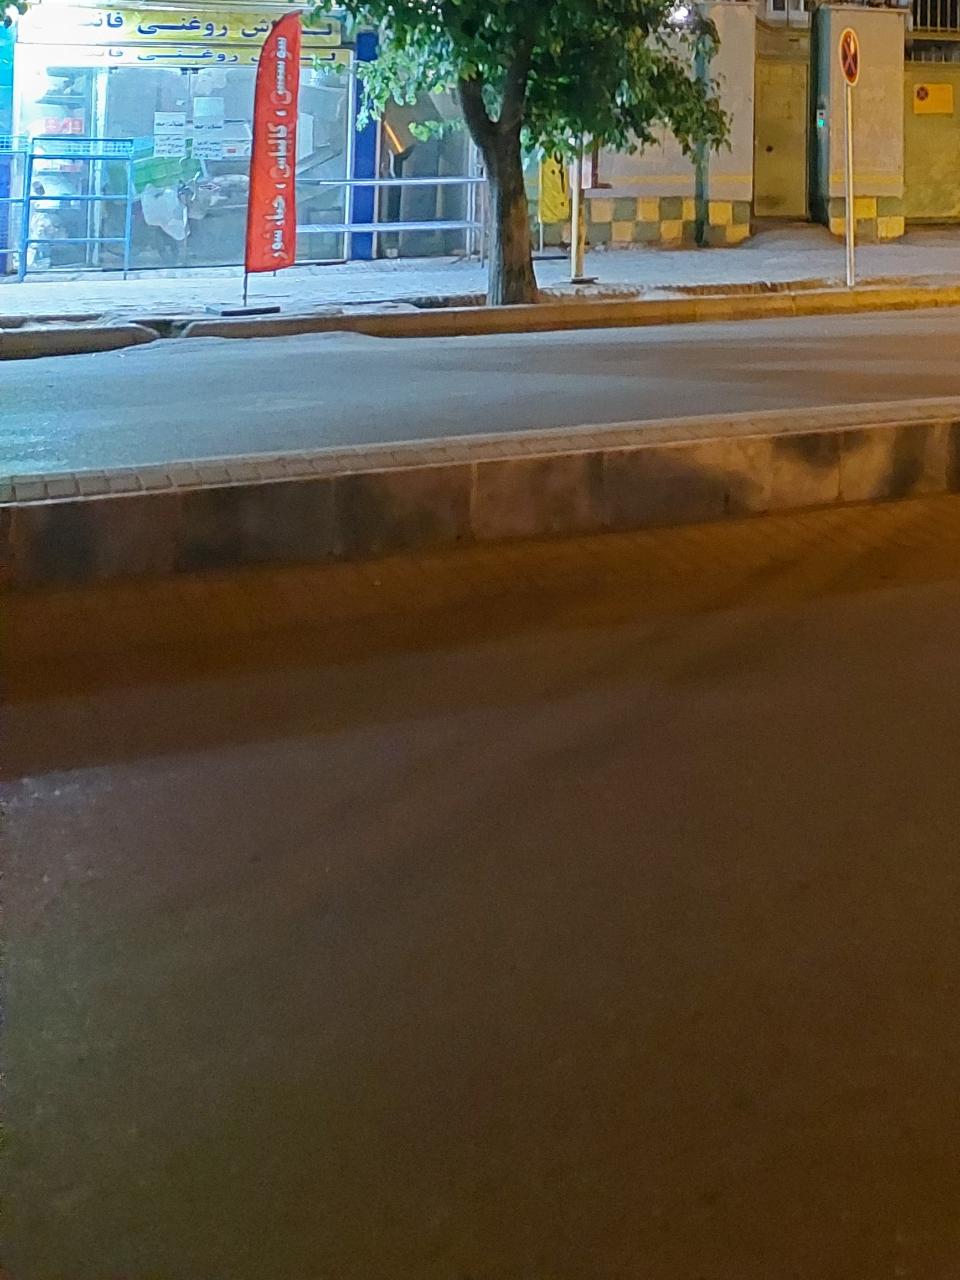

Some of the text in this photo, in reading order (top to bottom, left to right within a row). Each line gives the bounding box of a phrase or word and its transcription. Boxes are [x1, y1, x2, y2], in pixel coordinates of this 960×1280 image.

[137, 17, 228, 37] روغنی
[137, 49, 239, 63] روغنی
[267, 122, 291, 178] کالباس
